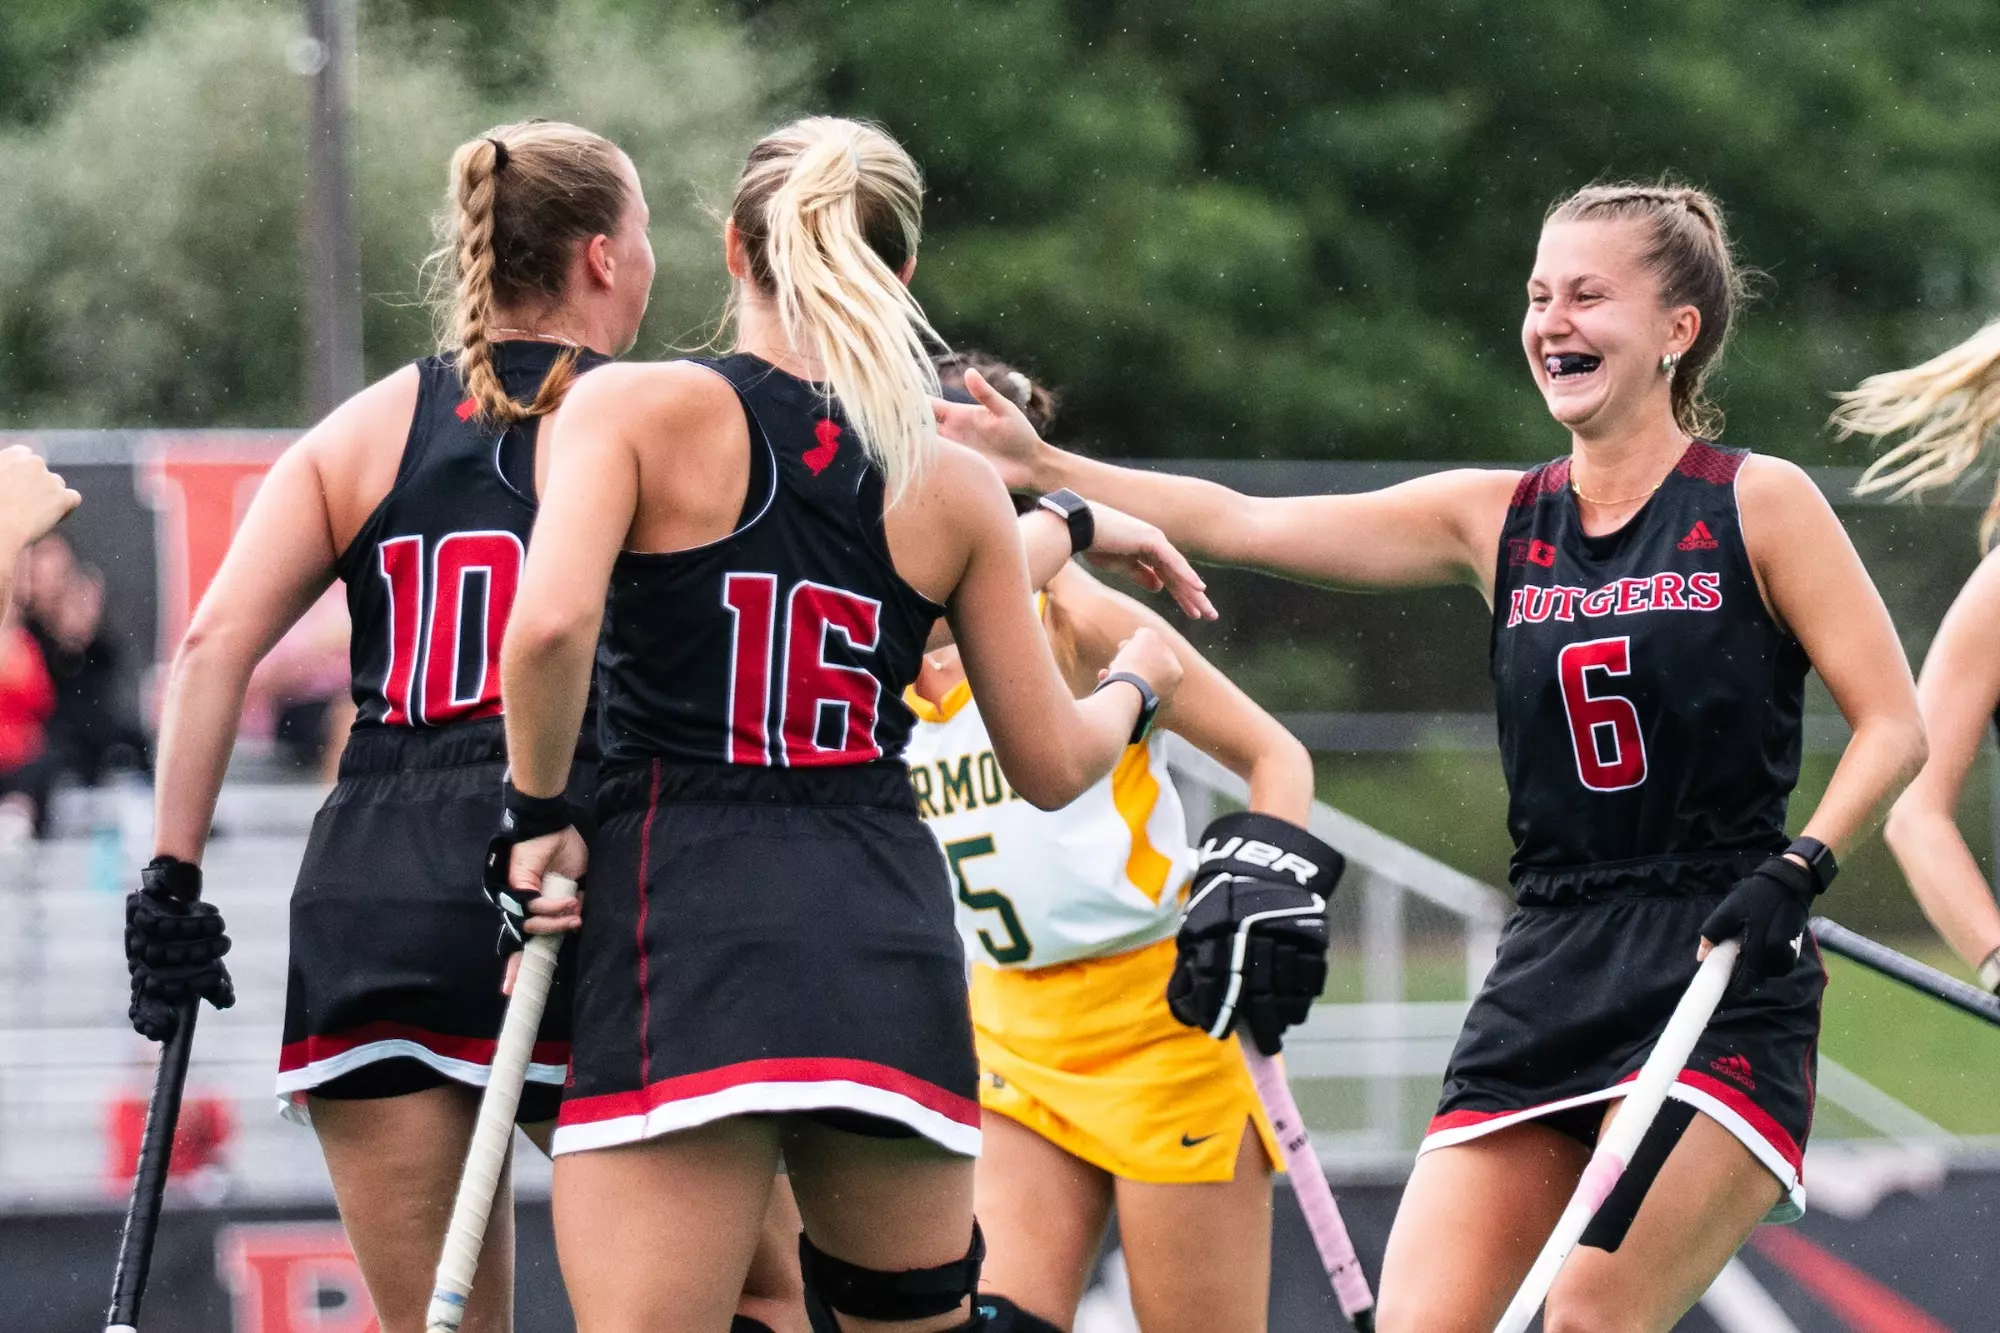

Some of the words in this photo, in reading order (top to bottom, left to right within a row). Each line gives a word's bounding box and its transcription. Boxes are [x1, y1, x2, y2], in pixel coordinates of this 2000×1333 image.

[379, 530, 526, 727] 10
[1507, 572, 1722, 627] RUTGERS
[723, 572, 883, 768] 16
[1558, 636, 1648, 792] 6
[910, 751, 1022, 820] RMO
[943, 831, 1033, 965] 5
[1199, 836, 1319, 885] UER
